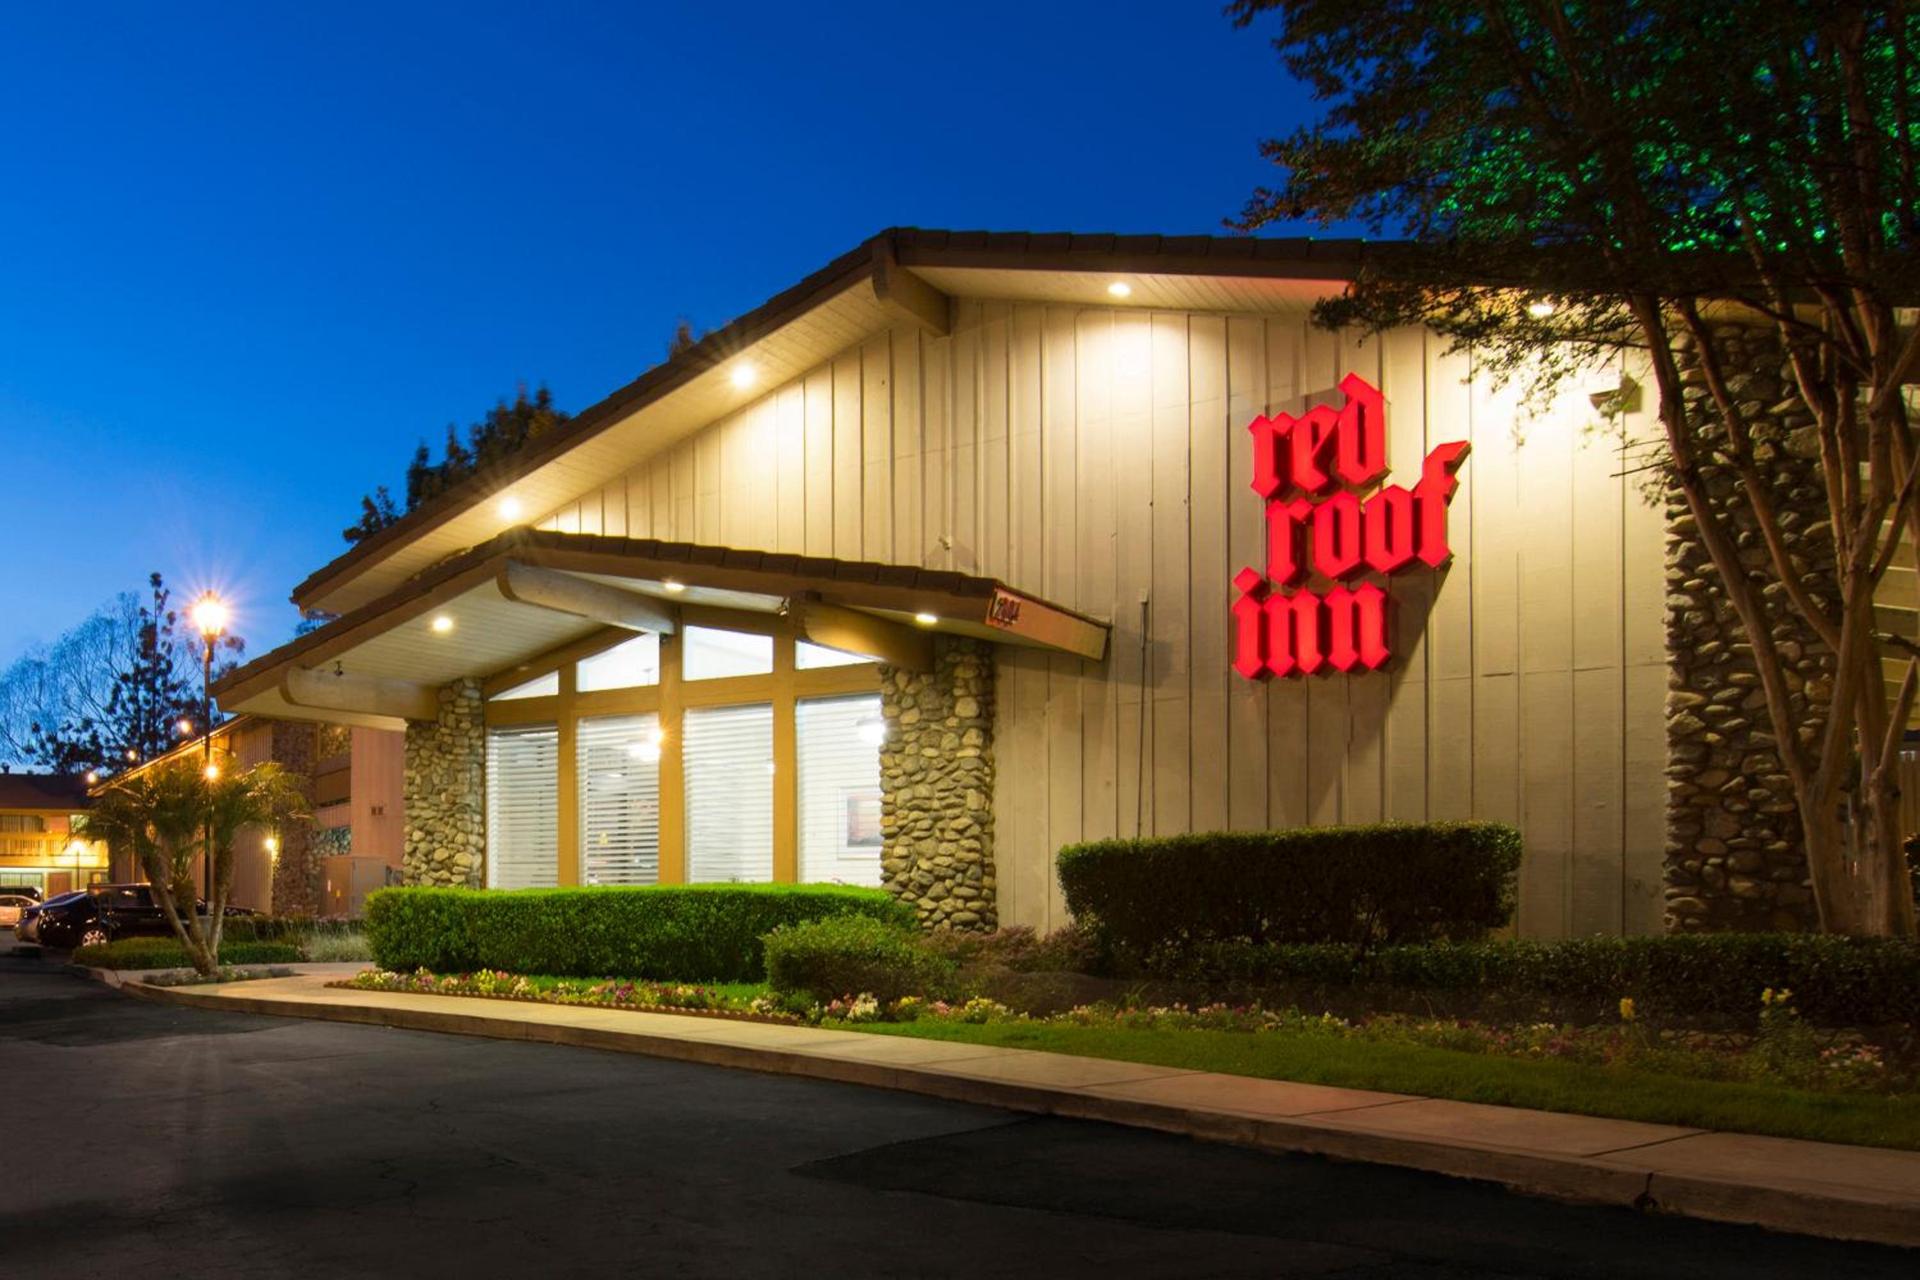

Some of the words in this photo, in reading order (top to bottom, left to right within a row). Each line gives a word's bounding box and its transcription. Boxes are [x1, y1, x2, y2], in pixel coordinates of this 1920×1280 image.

[1248, 372, 1388, 499] red
[1265, 440, 1471, 586] roof
[1231, 566, 1390, 679] inn
